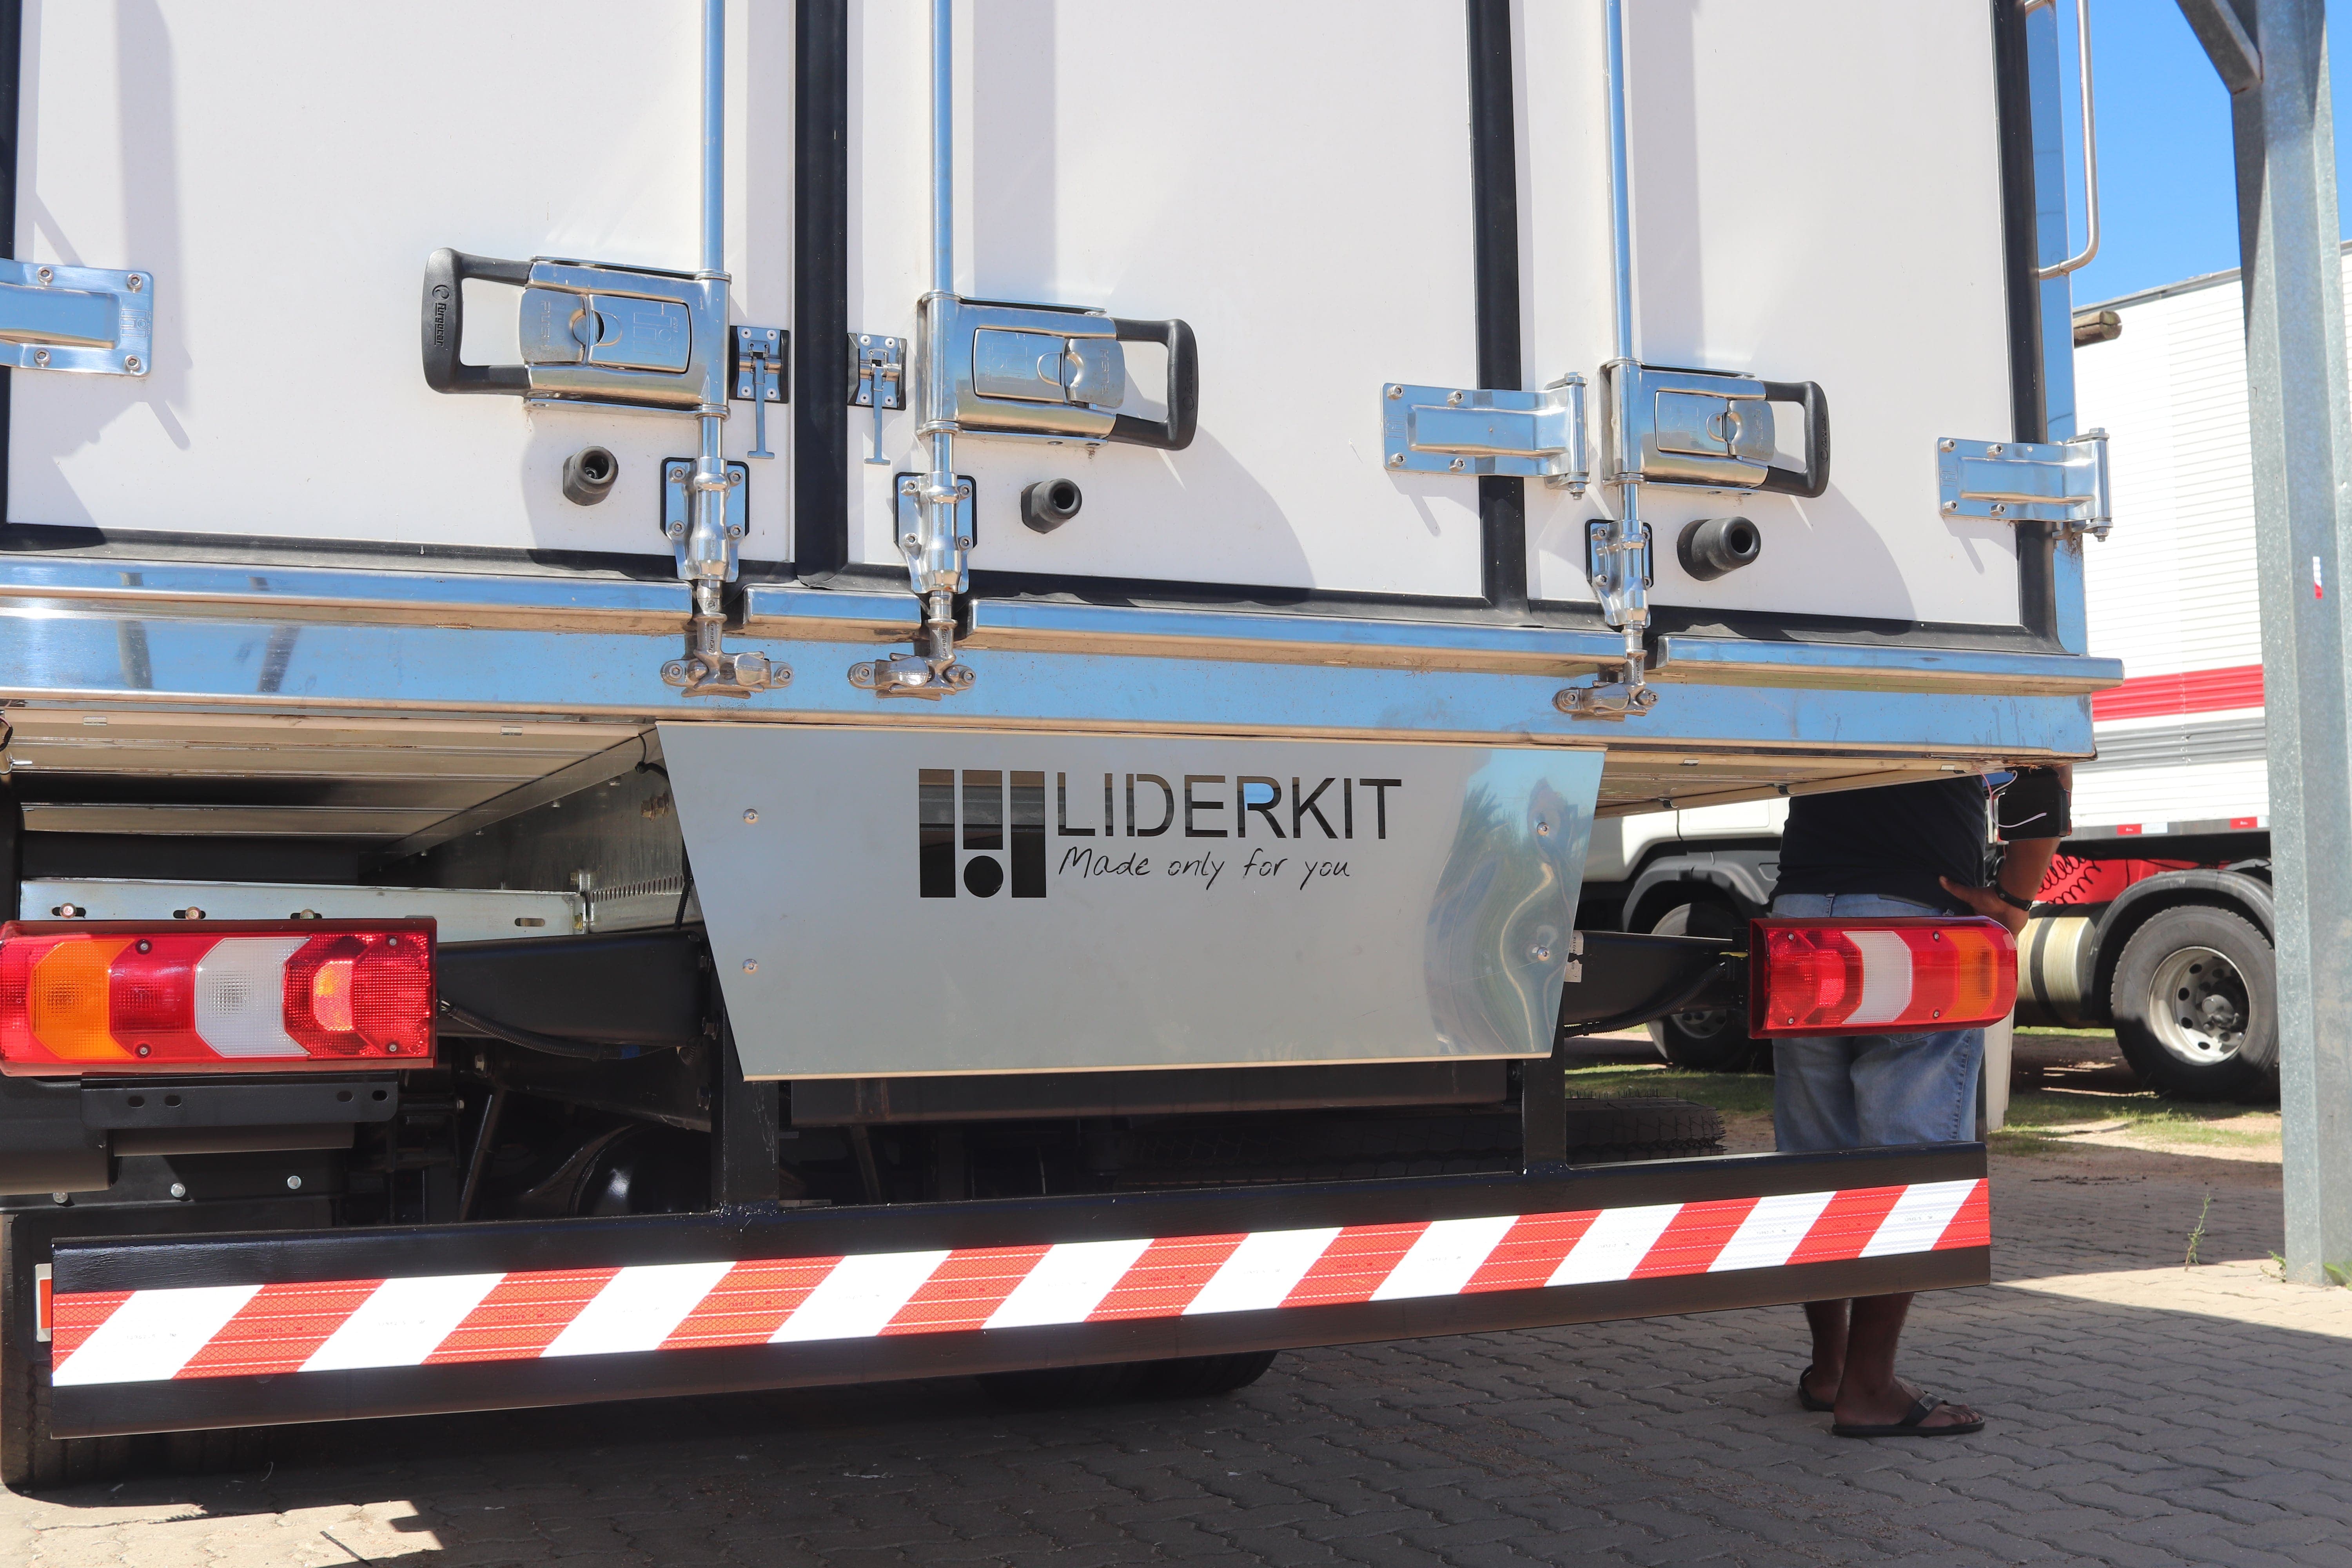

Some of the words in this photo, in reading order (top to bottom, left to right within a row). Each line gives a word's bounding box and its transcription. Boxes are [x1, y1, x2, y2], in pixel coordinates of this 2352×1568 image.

[1057, 772, 1402, 839] LIDERKIT
[1058, 846, 1151, 878] Made
[1168, 857, 1223, 889] only
[1242, 847, 1288, 878] for
[1300, 860, 1350, 890] you
